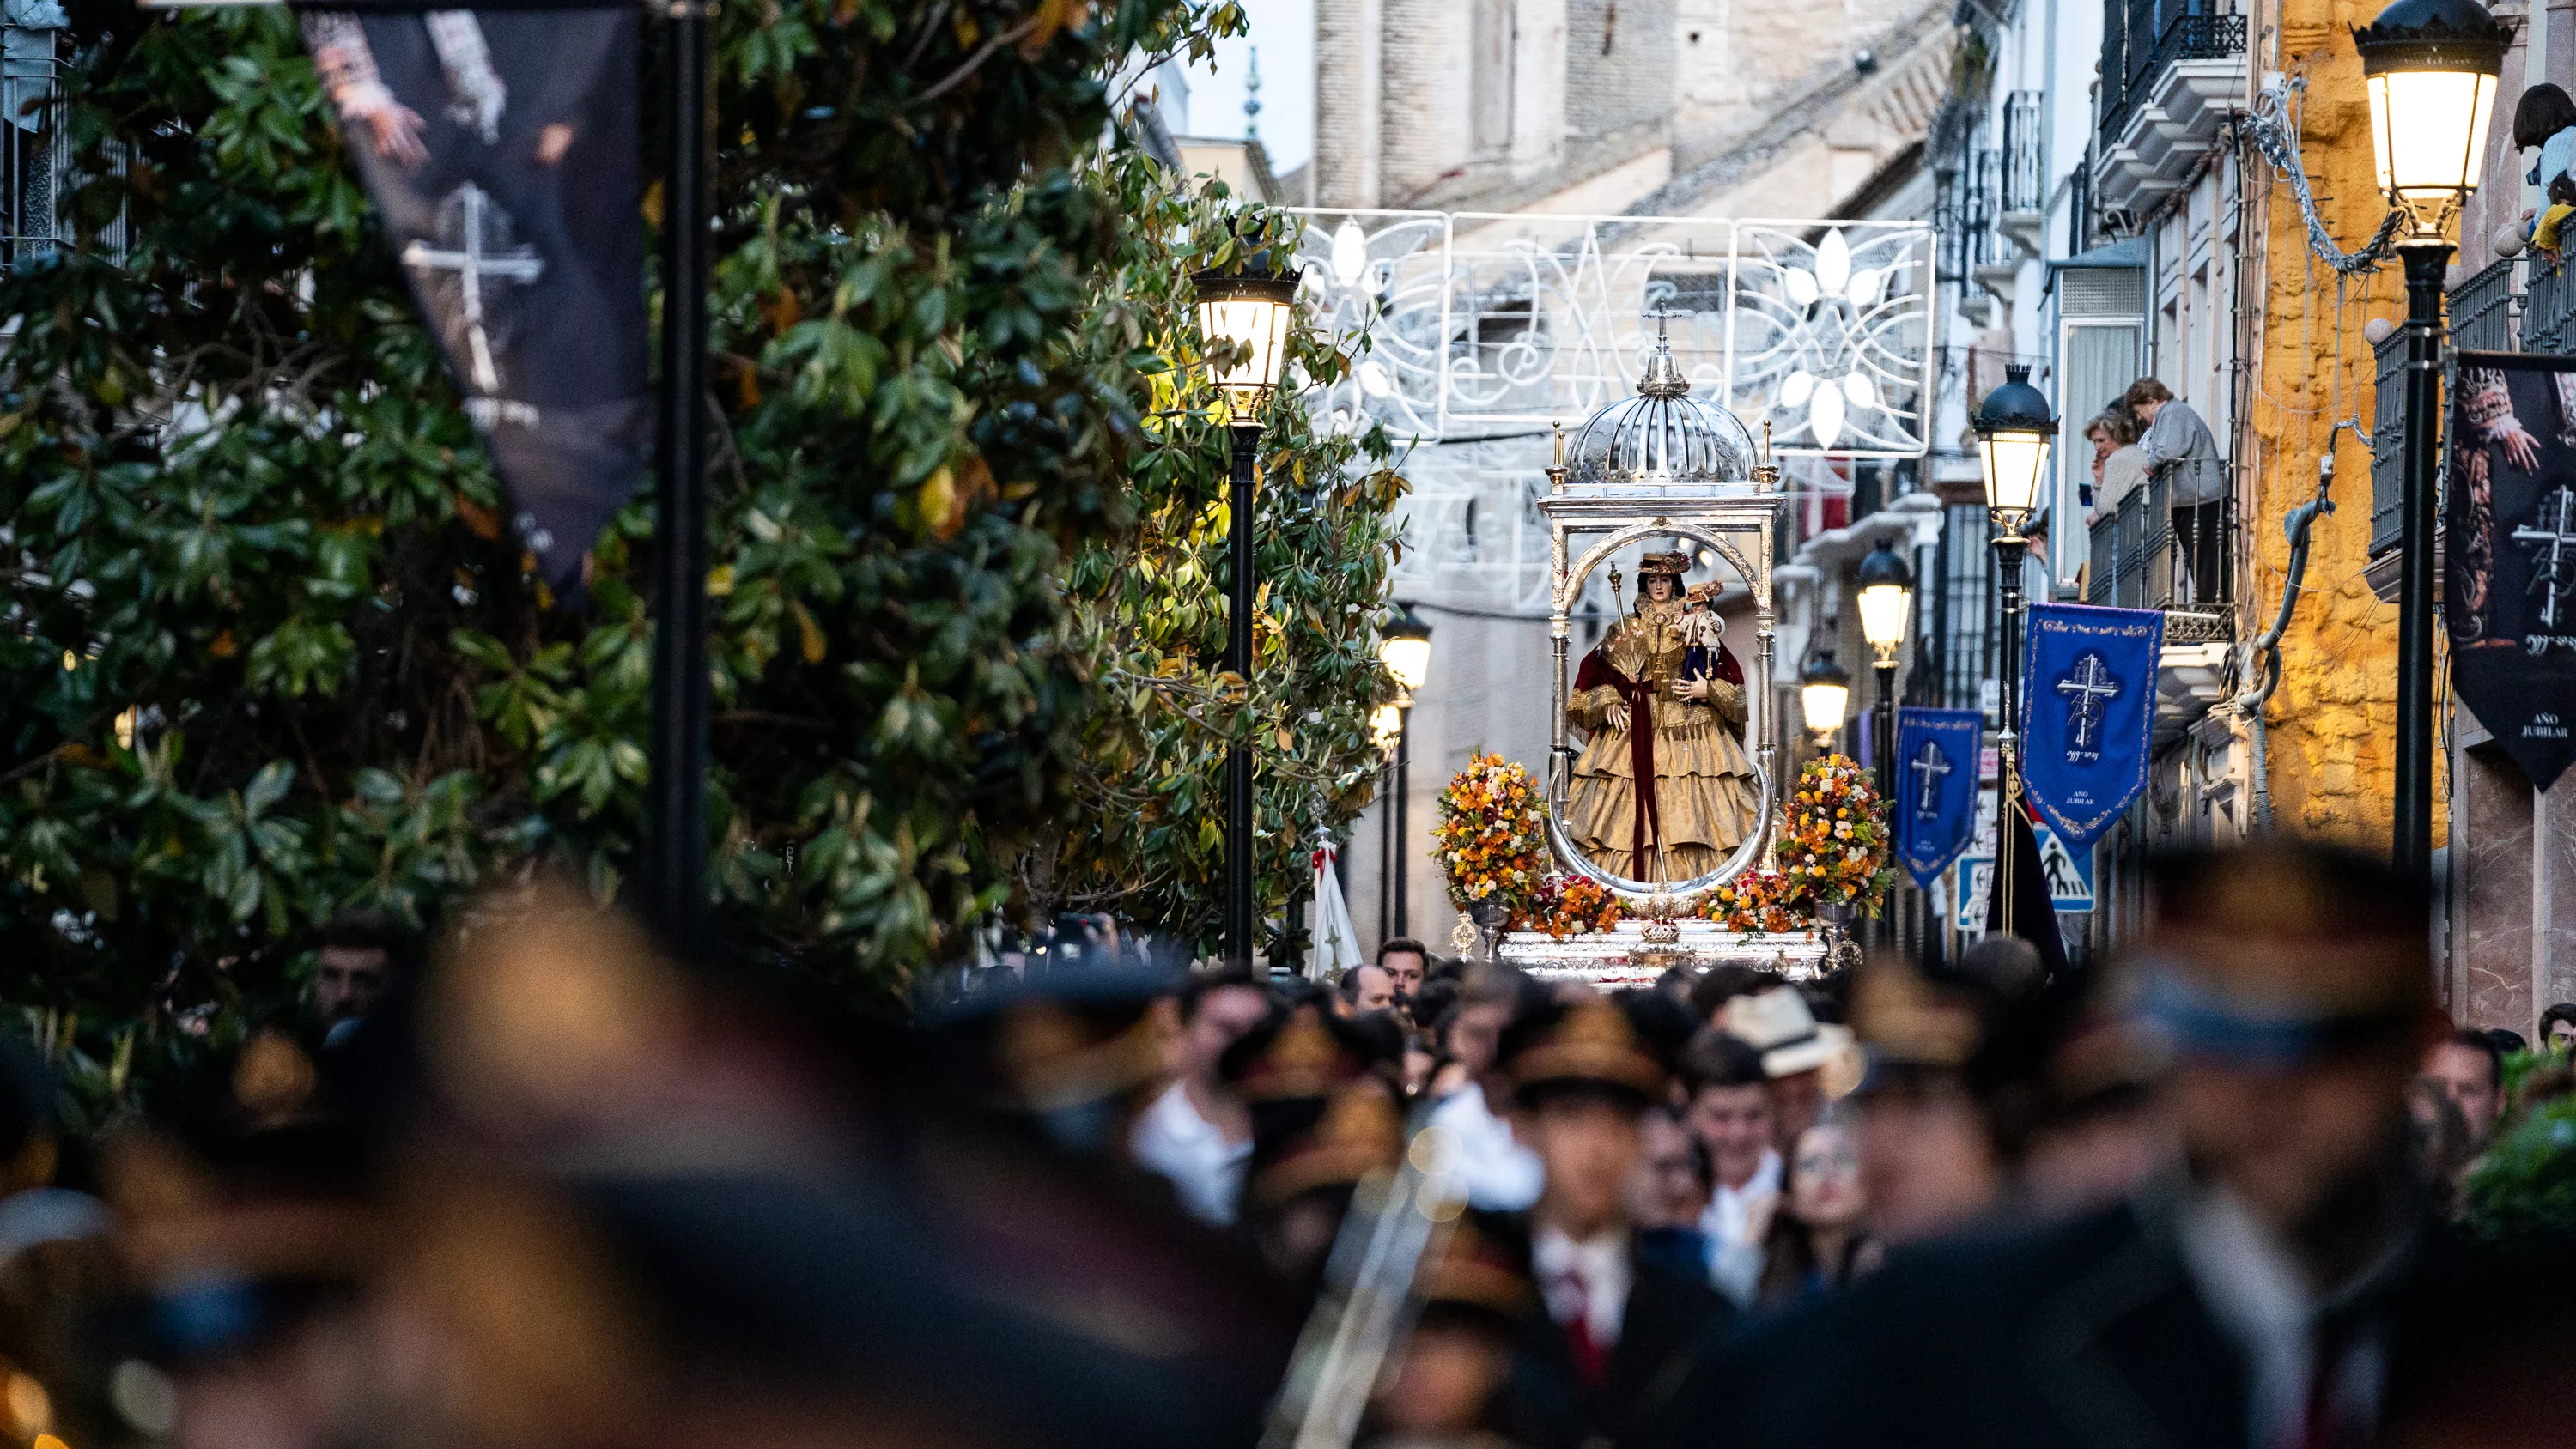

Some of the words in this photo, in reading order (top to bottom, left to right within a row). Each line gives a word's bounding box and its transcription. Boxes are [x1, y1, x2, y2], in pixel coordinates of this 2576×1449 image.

[2533, 711, 2559, 725] AÑO
[2521, 725, 2568, 739] JUBILAR
[2073, 790, 2089, 798] AÑO
